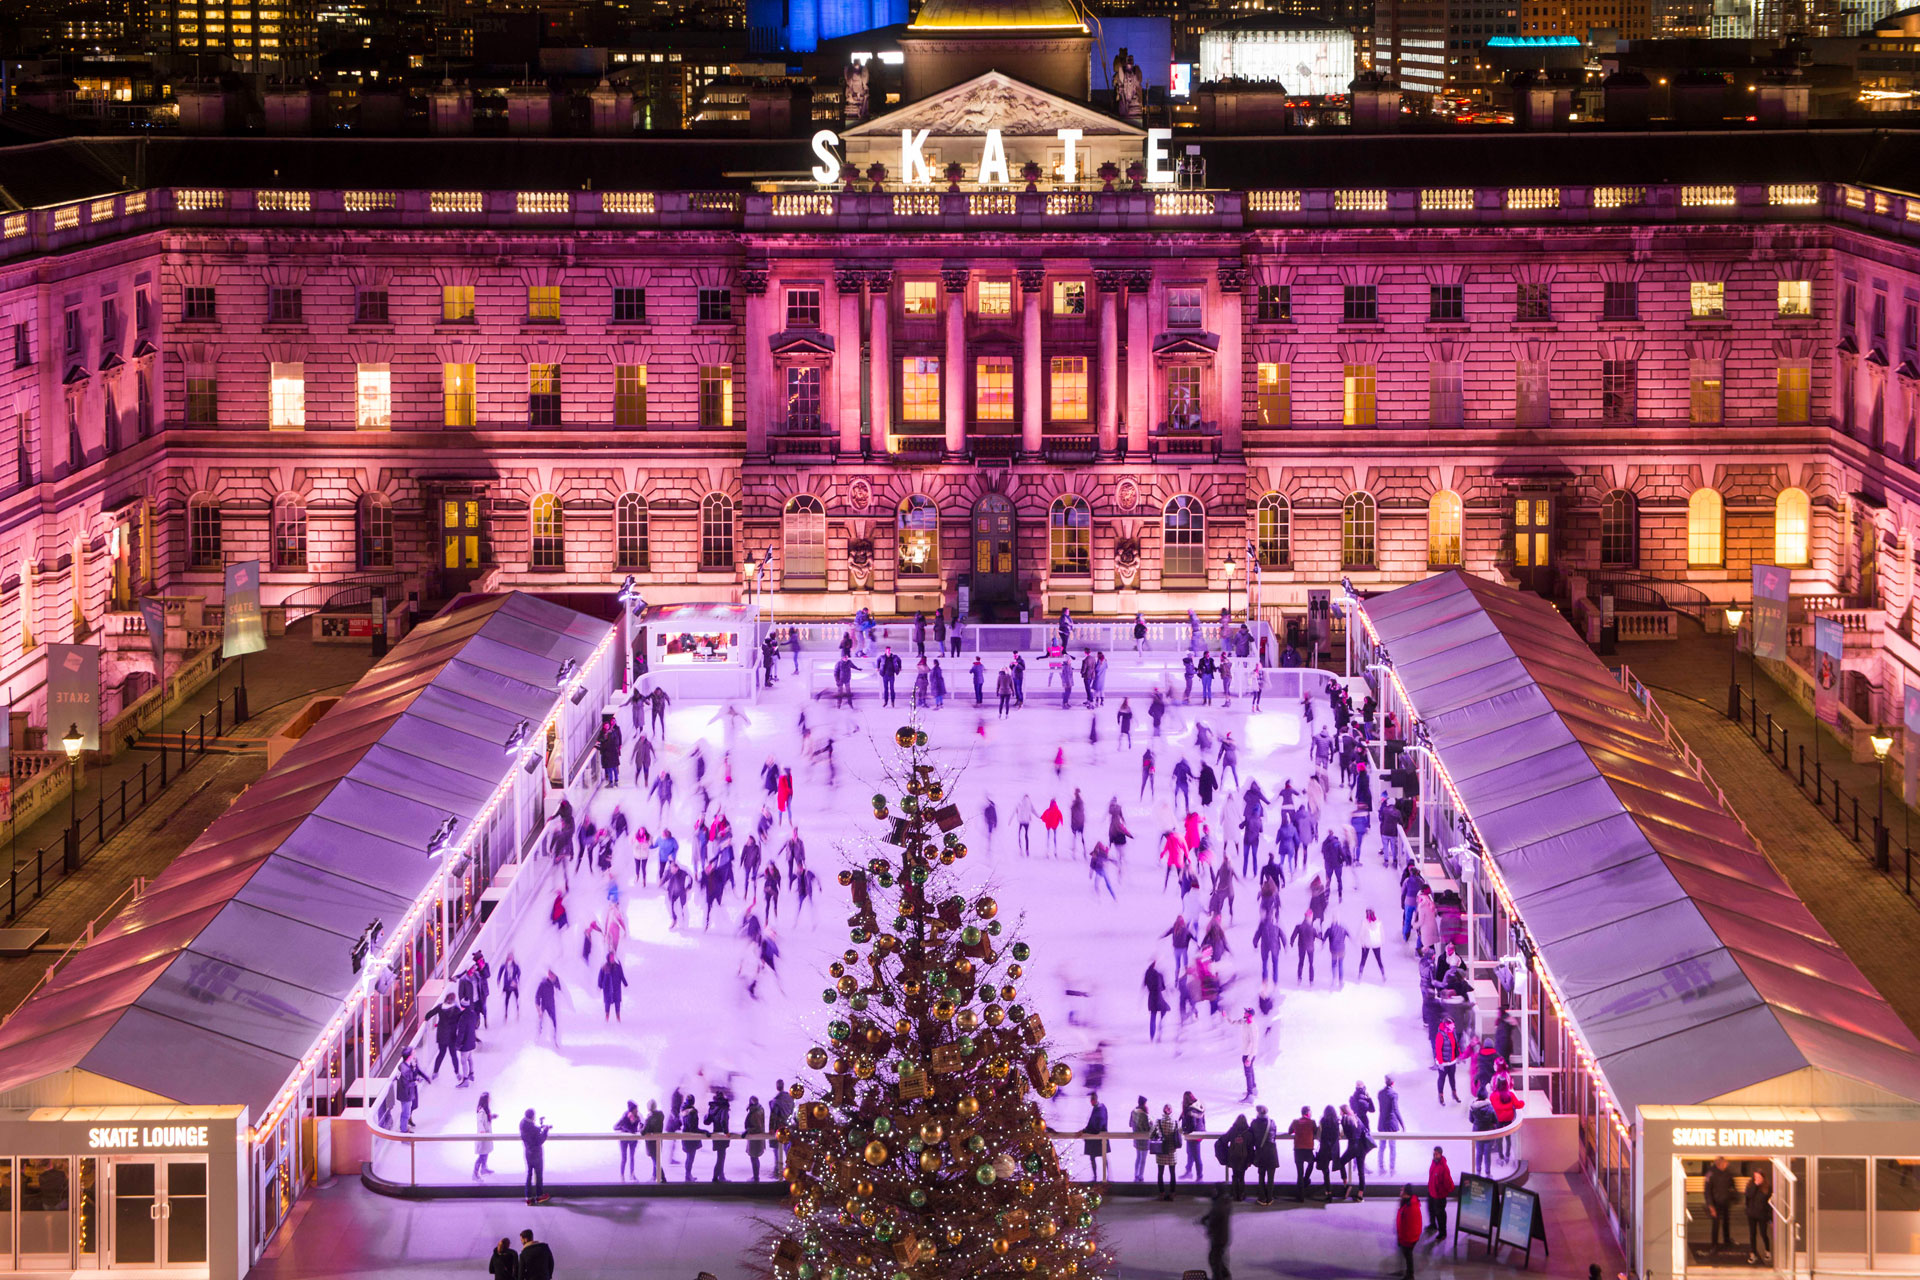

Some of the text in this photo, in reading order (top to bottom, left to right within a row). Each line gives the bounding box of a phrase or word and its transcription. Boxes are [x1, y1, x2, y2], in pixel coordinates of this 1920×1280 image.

[811, 128, 1174, 184] SKATE
[230, 602, 254, 615] SKATE
[88, 1126, 209, 1148] SKATE LOUNGE
[1672, 1128, 1795, 1147] SKATE ENTRANCE
